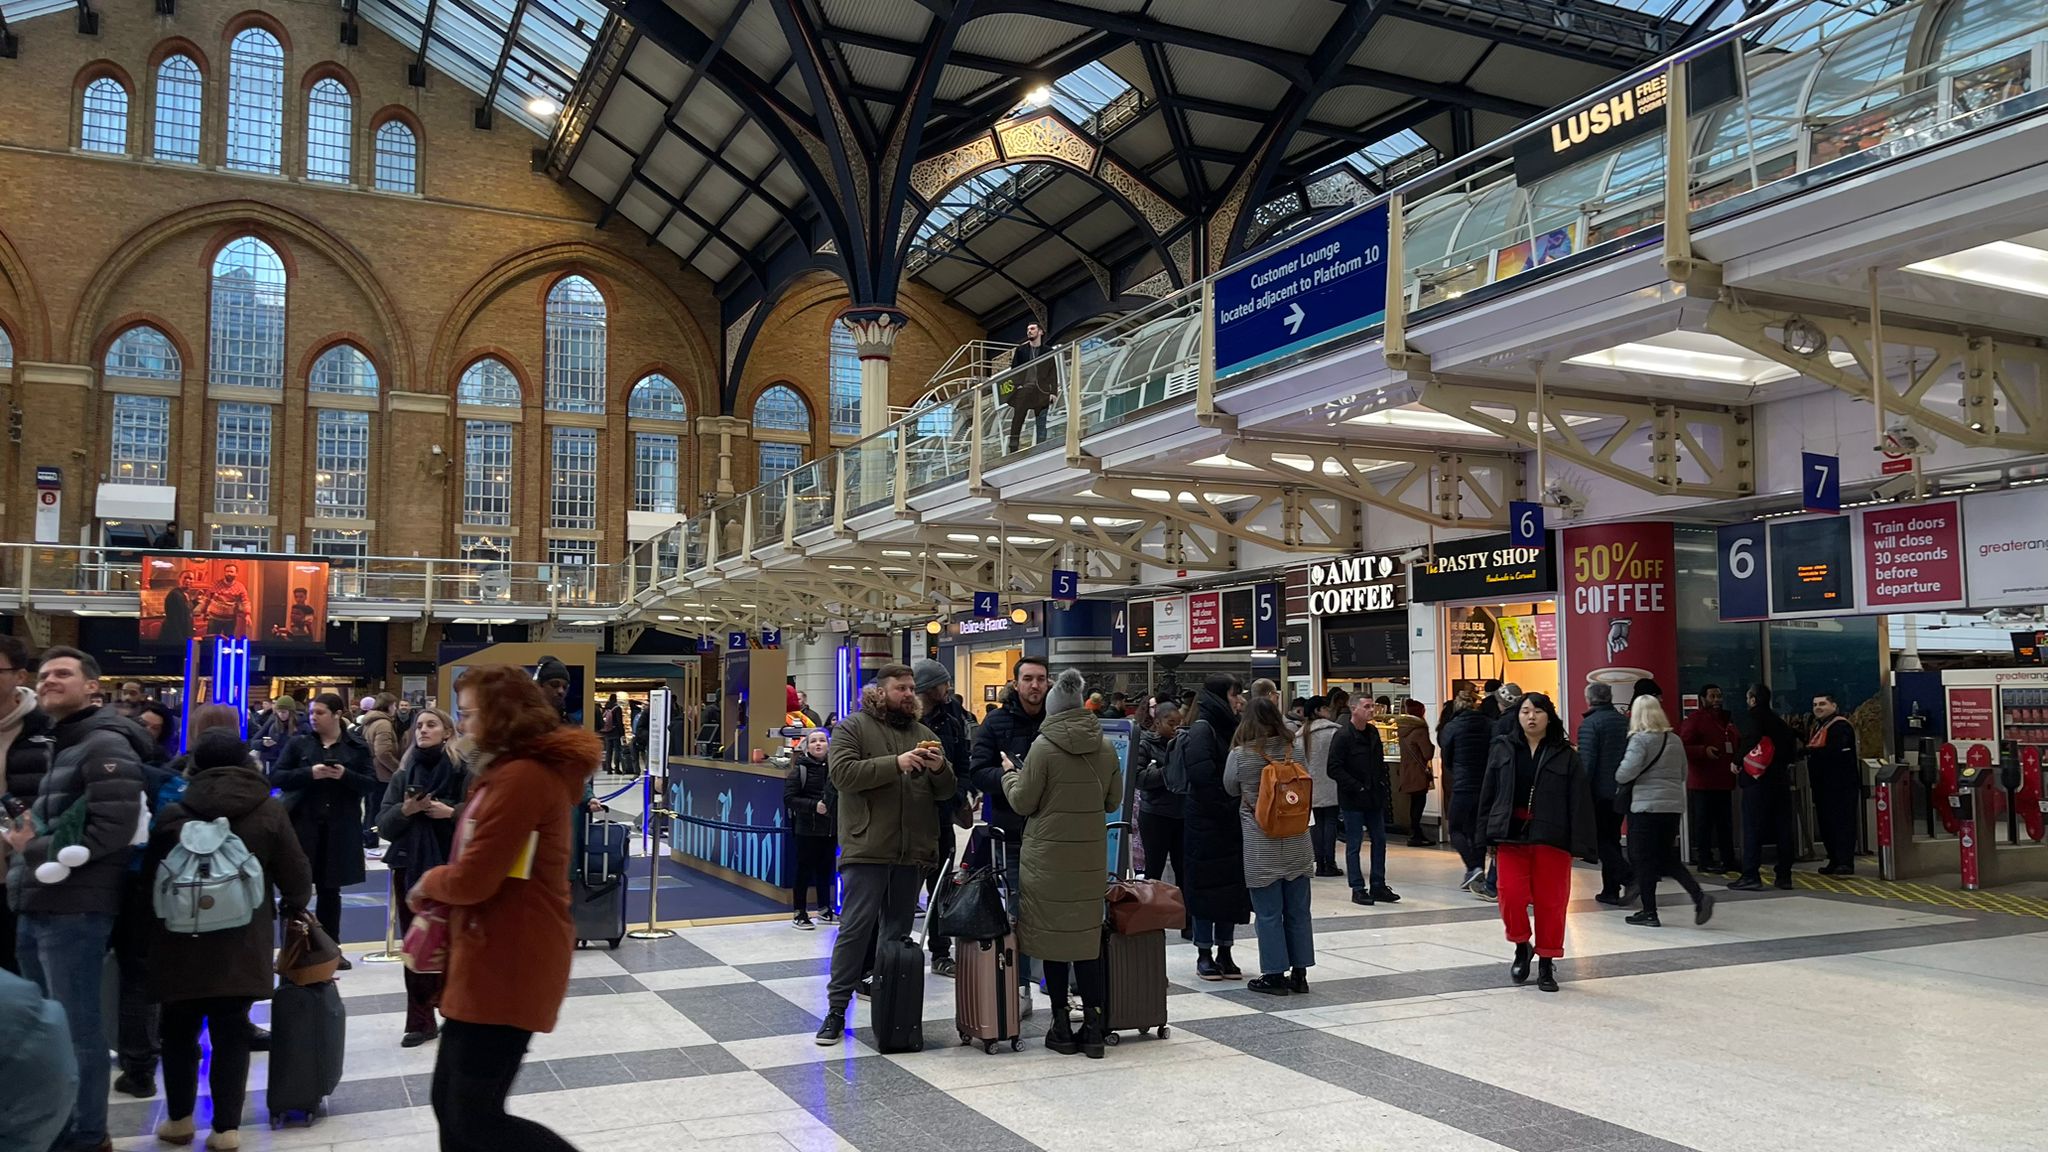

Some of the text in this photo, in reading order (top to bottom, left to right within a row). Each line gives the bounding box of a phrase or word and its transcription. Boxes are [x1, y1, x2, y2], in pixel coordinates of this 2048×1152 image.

[1635, 75, 1667, 98] FRES
[1551, 90, 1635, 153] LUSH
[1251, 241, 1340, 289] Customer Lounge
[1220, 244, 1380, 325] located adjacent to Platform 10
[1814, 465, 1829, 499] 7
[1520, 510, 1535, 538] 6
[1872, 517, 1945, 534] Train doors
[1873, 534, 1933, 549] will close
[1979, 540, 2048, 557] greateran
[1425, 547, 1540, 575] The PASTY SHOP
[1574, 541, 1664, 583] 50% OFF
[1729, 537, 1755, 579] 6
[1874, 546, 1948, 565] 30 seconds
[1324, 555, 1377, 586] AMT
[1875, 566, 1918, 580] before
[1059, 576, 1069, 594] 5
[1876, 581, 1941, 597] departure
[980, 596, 992, 612] 4
[1260, 593, 1272, 622] 5
[1309, 583, 1394, 616] COFFEE
[1574, 583, 1665, 615] COFFEE
[984, 617, 1008, 632] France
[1114, 610, 1125, 633] 4
[1199, 616, 1217, 625] seconds
[557, 626, 596, 634] Central line
[767, 632, 776, 642] 3
[1192, 626, 1207, 635] before
[733, 635, 741, 647] 2
[1192, 636, 1214, 644] departure
[1952, 721, 1966, 729] right
